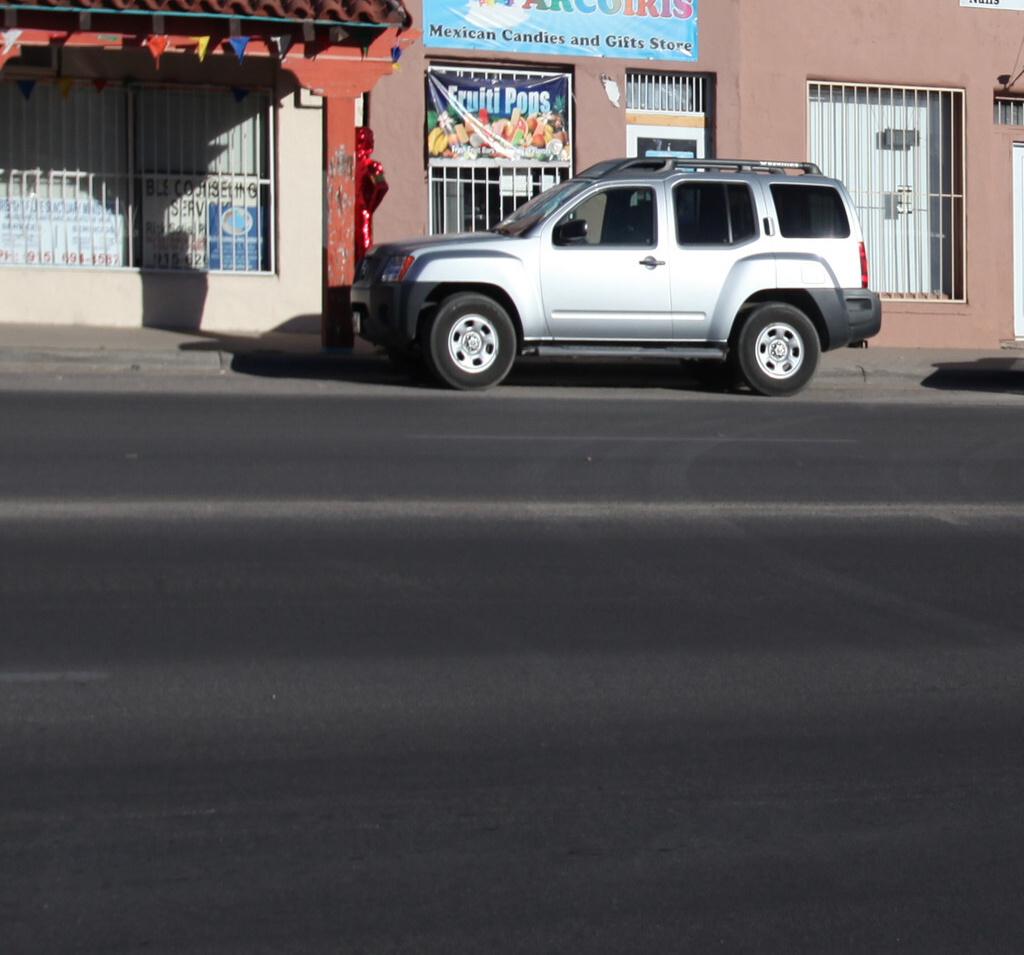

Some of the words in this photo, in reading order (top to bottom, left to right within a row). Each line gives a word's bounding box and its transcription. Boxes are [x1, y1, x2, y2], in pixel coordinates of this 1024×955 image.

[429, 24, 496, 40] Mexican
[502, 29, 565, 45] Candies
[571, 34, 600, 47] and
[606, 35, 644, 49] Gifts
[650, 37, 692, 52] Store
[505, 87, 551, 115] Pops
